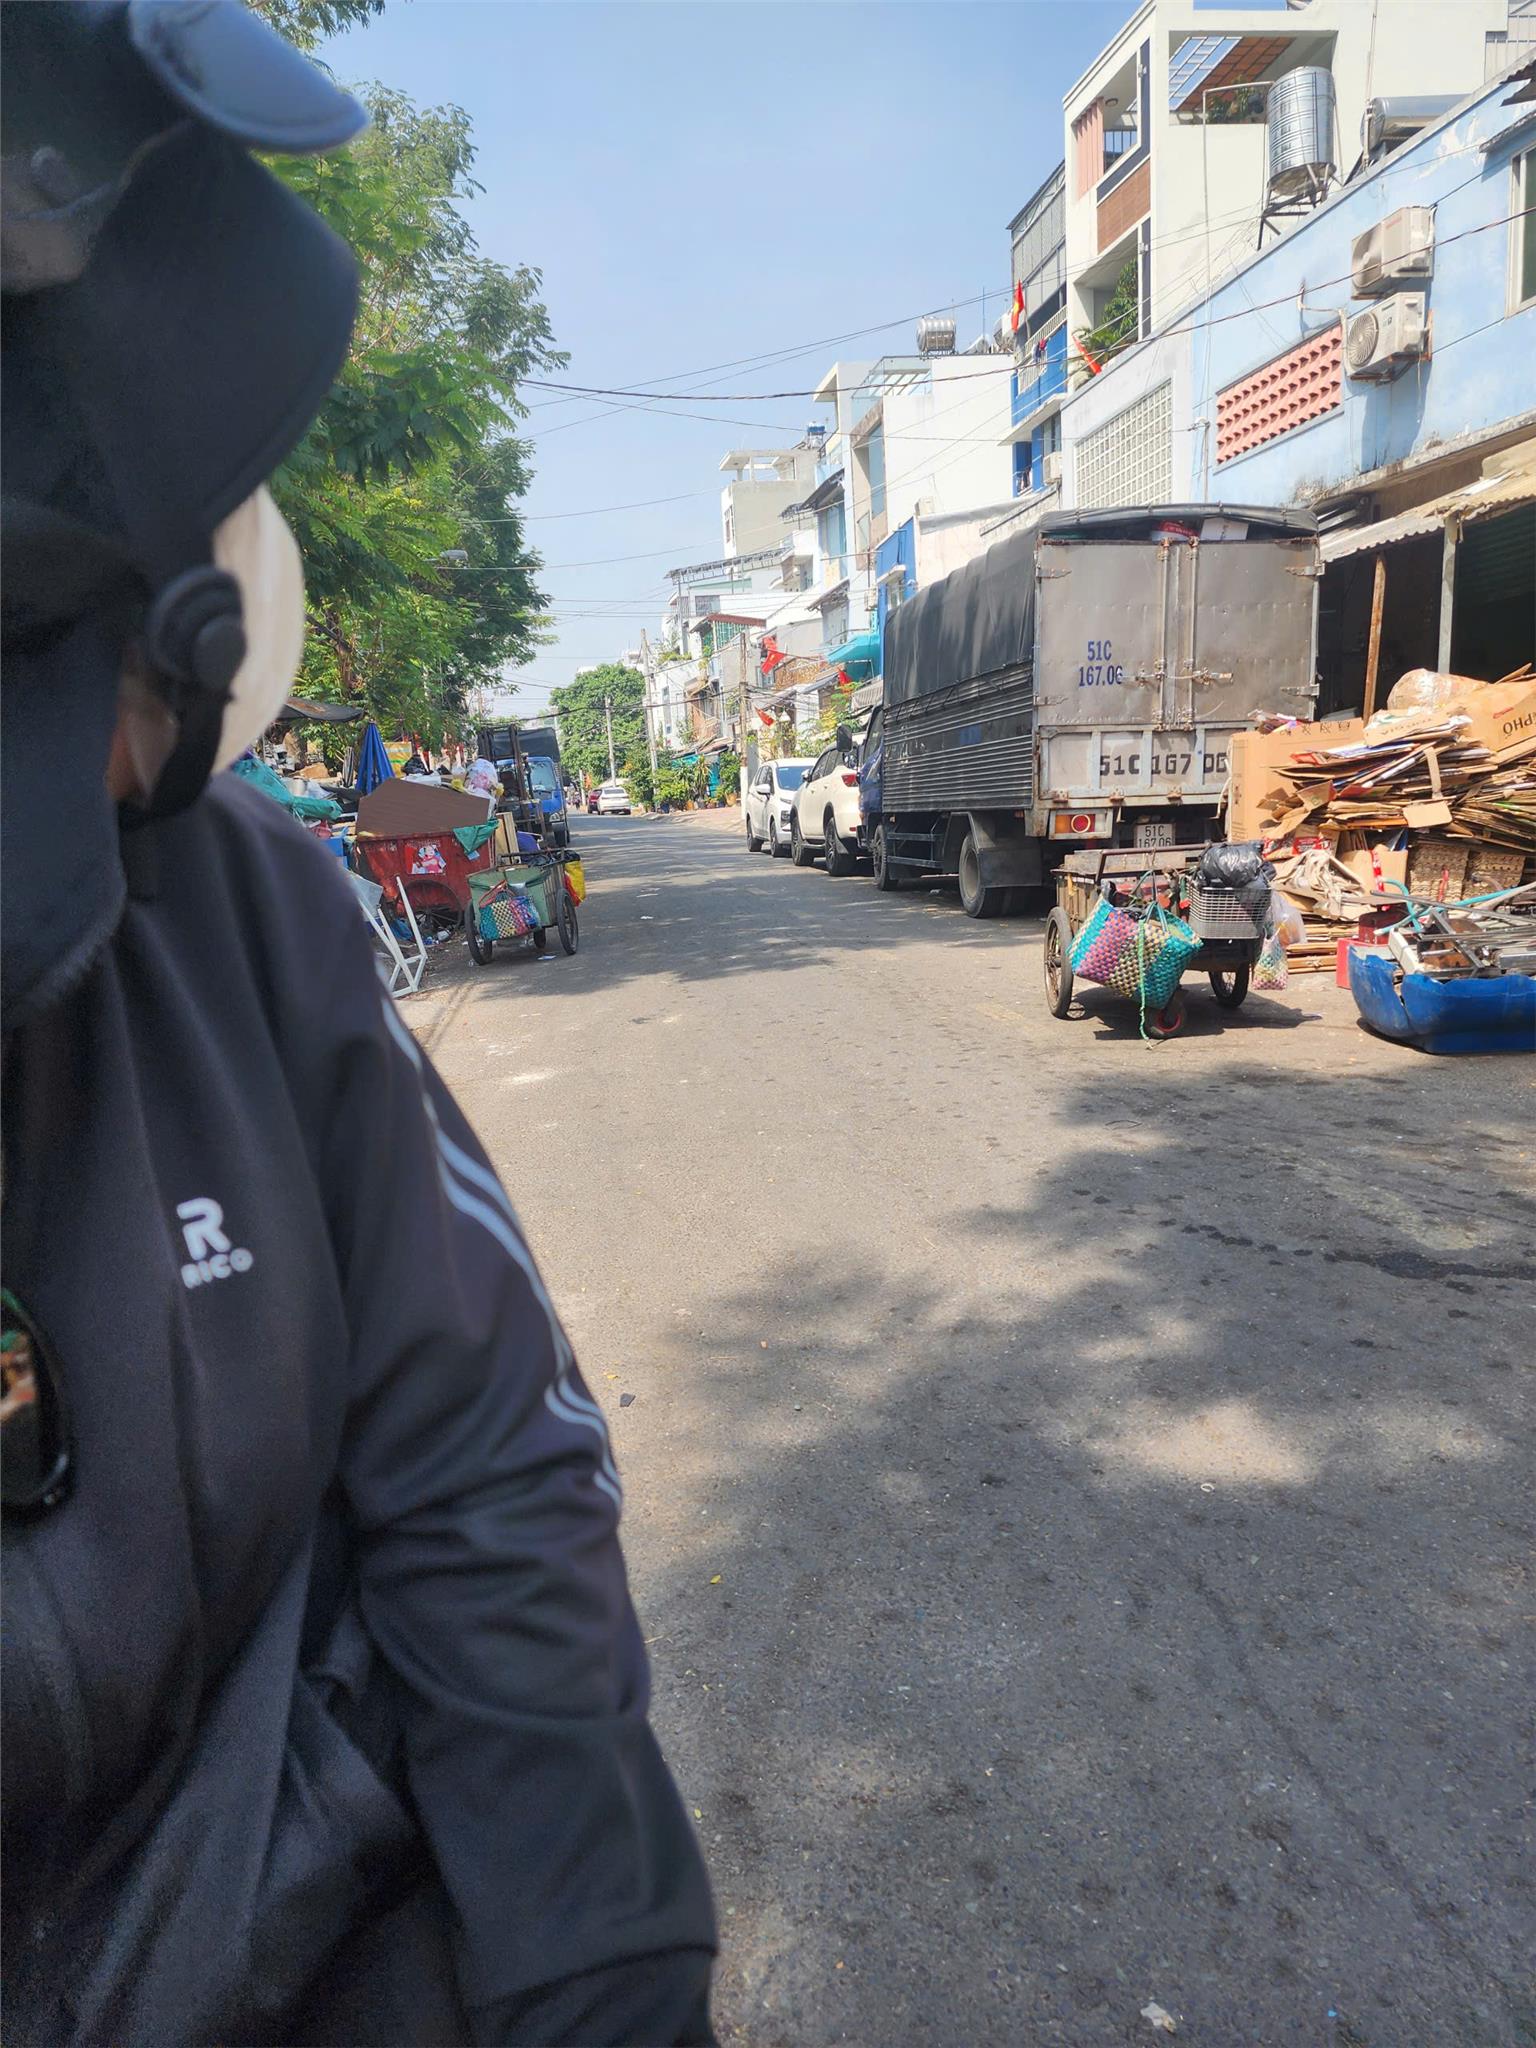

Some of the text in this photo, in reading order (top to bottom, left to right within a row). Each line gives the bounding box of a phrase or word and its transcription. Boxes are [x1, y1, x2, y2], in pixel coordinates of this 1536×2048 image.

[1087, 640, 1112, 662] 51C
[1100, 753, 1140, 776] 51C
[1144, 825, 1165, 837] 51C
